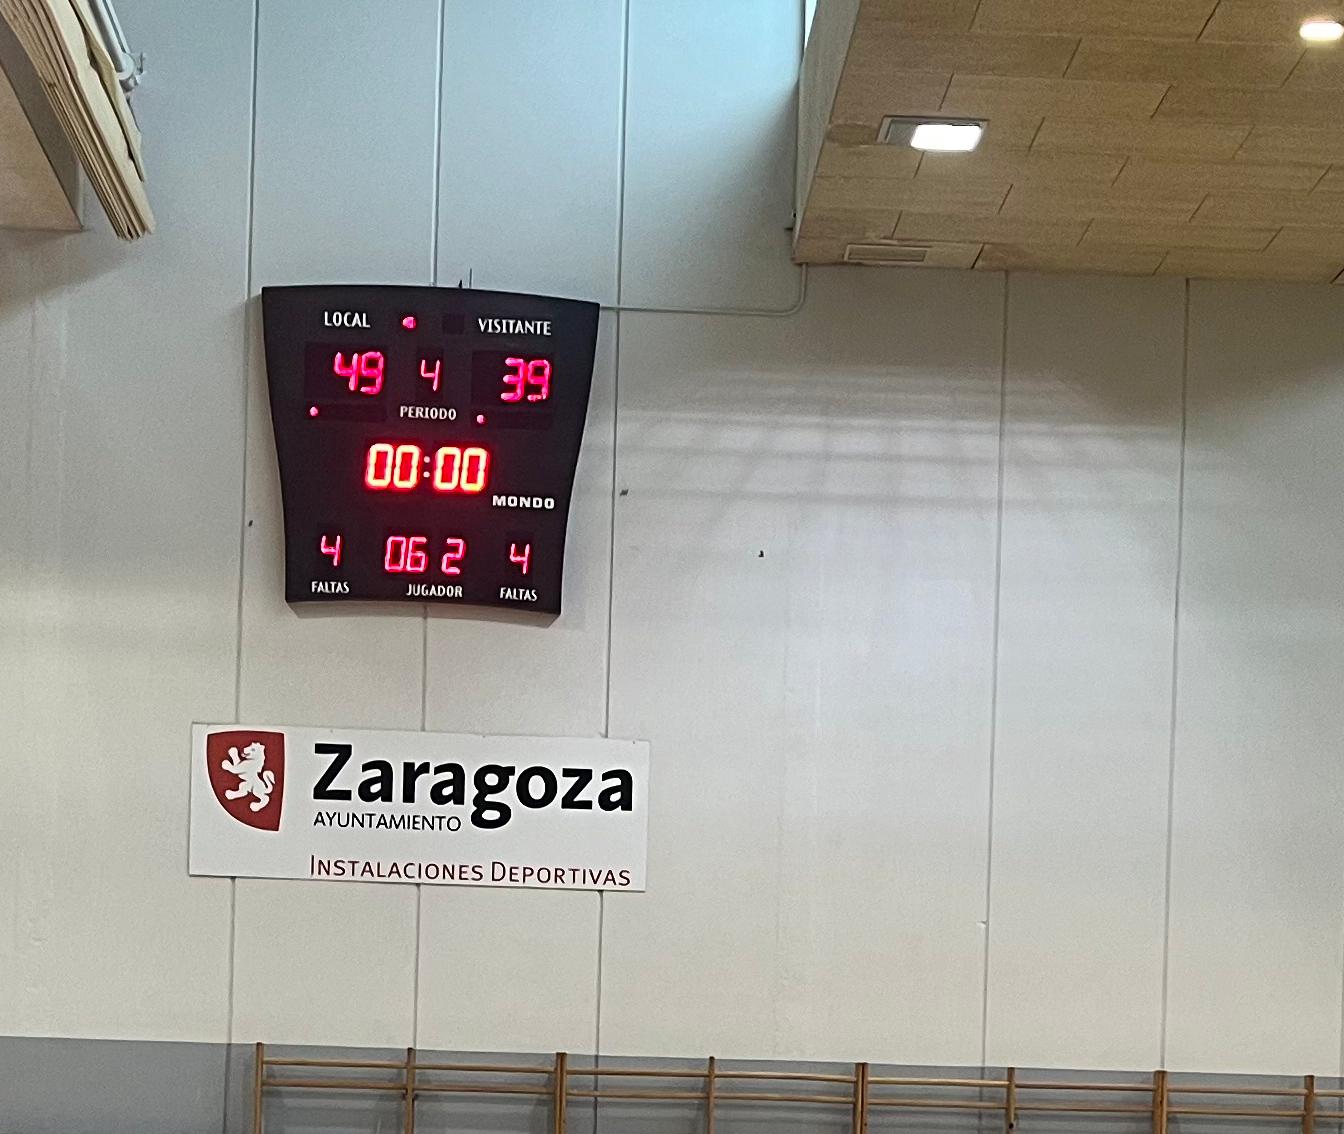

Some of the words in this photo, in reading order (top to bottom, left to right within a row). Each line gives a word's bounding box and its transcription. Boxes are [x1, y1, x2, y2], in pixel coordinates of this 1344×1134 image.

[323, 311, 371, 329] LOCAL
[477, 317, 552, 337] VISITANTE
[333, 351, 385, 395] 49
[420, 358, 441, 392] 4
[500, 356, 551, 402] 39
[399, 405, 457, 421] PERIODO
[366, 443, 489, 493] 00:00
[492, 494, 555, 510] MONDO
[320, 534, 342, 567] 4
[509, 542, 531, 575] 4
[311, 580, 350, 595] FALTAS
[406, 583, 463, 598] JUGADOR
[499, 586, 538, 602] FALTAS
[312, 742, 635, 830] Zaragoza
[312, 810, 462, 832] AYUNTAMIENTO
